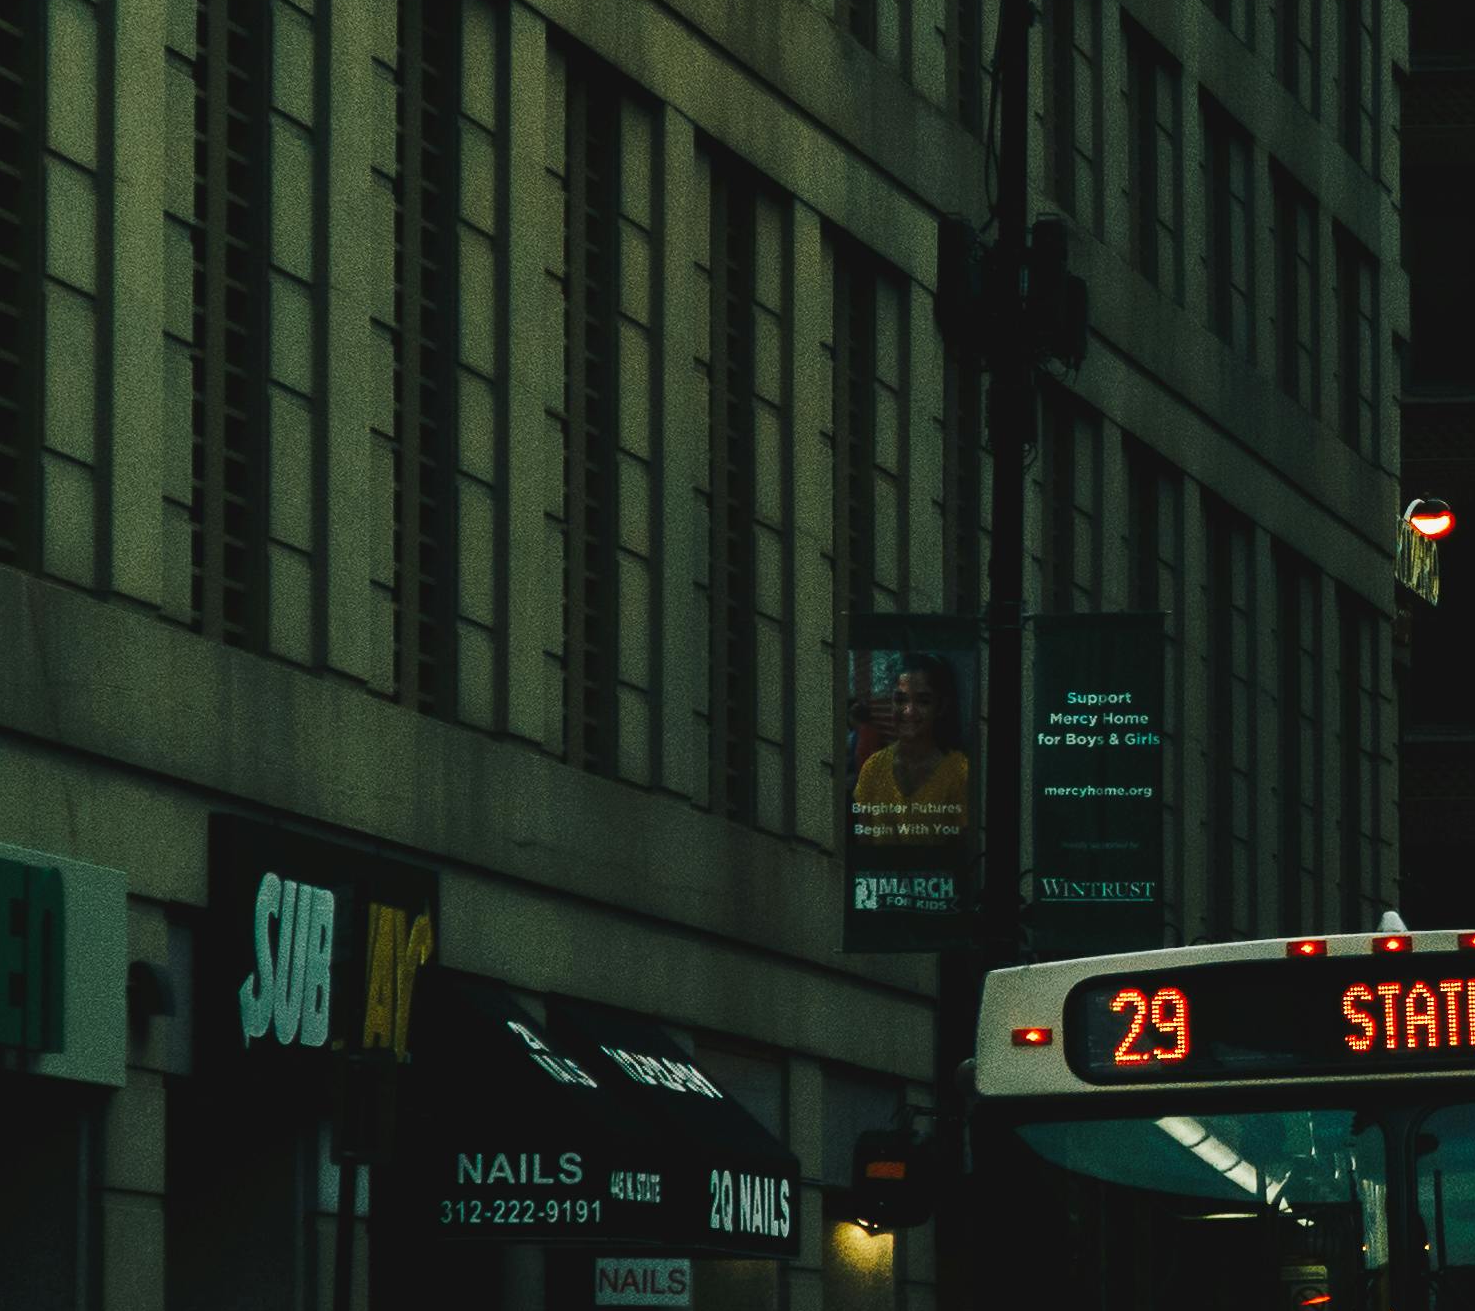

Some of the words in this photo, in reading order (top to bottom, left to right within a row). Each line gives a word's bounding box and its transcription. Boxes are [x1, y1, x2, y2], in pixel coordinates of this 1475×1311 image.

[1066, 690, 1133, 707] Support
[1049, 712, 1099, 728] Mercy
[1102, 712, 1150, 726] Home
[1037, 731, 1062, 746] for
[1065, 731, 1105, 749] Boys
[1108, 732, 1120, 746] &
[1124, 731, 1161, 747] Girls
[1043, 783, 1155, 799] mercyhome.org
[851, 801, 909, 817] Brighter
[911, 801, 963, 815] Futures
[853, 822, 894, 838] Begin
[896, 822, 930, 836] With
[932, 822, 961, 836] You
[878, 876, 956, 900] MARCH
[1041, 877, 1156, 898] WINTRUST
[238, 871, 433, 1065] SUBAY
[1112, 986, 1191, 1063] 29
[456, 1151, 585, 1187] NAILS
[439, 1198, 603, 1225] 312-222-9191
[709, 1168, 735, 1234] 2Q
[738, 1172, 792, 1239] NAILS
[598, 1268, 687, 1295] NAILS
